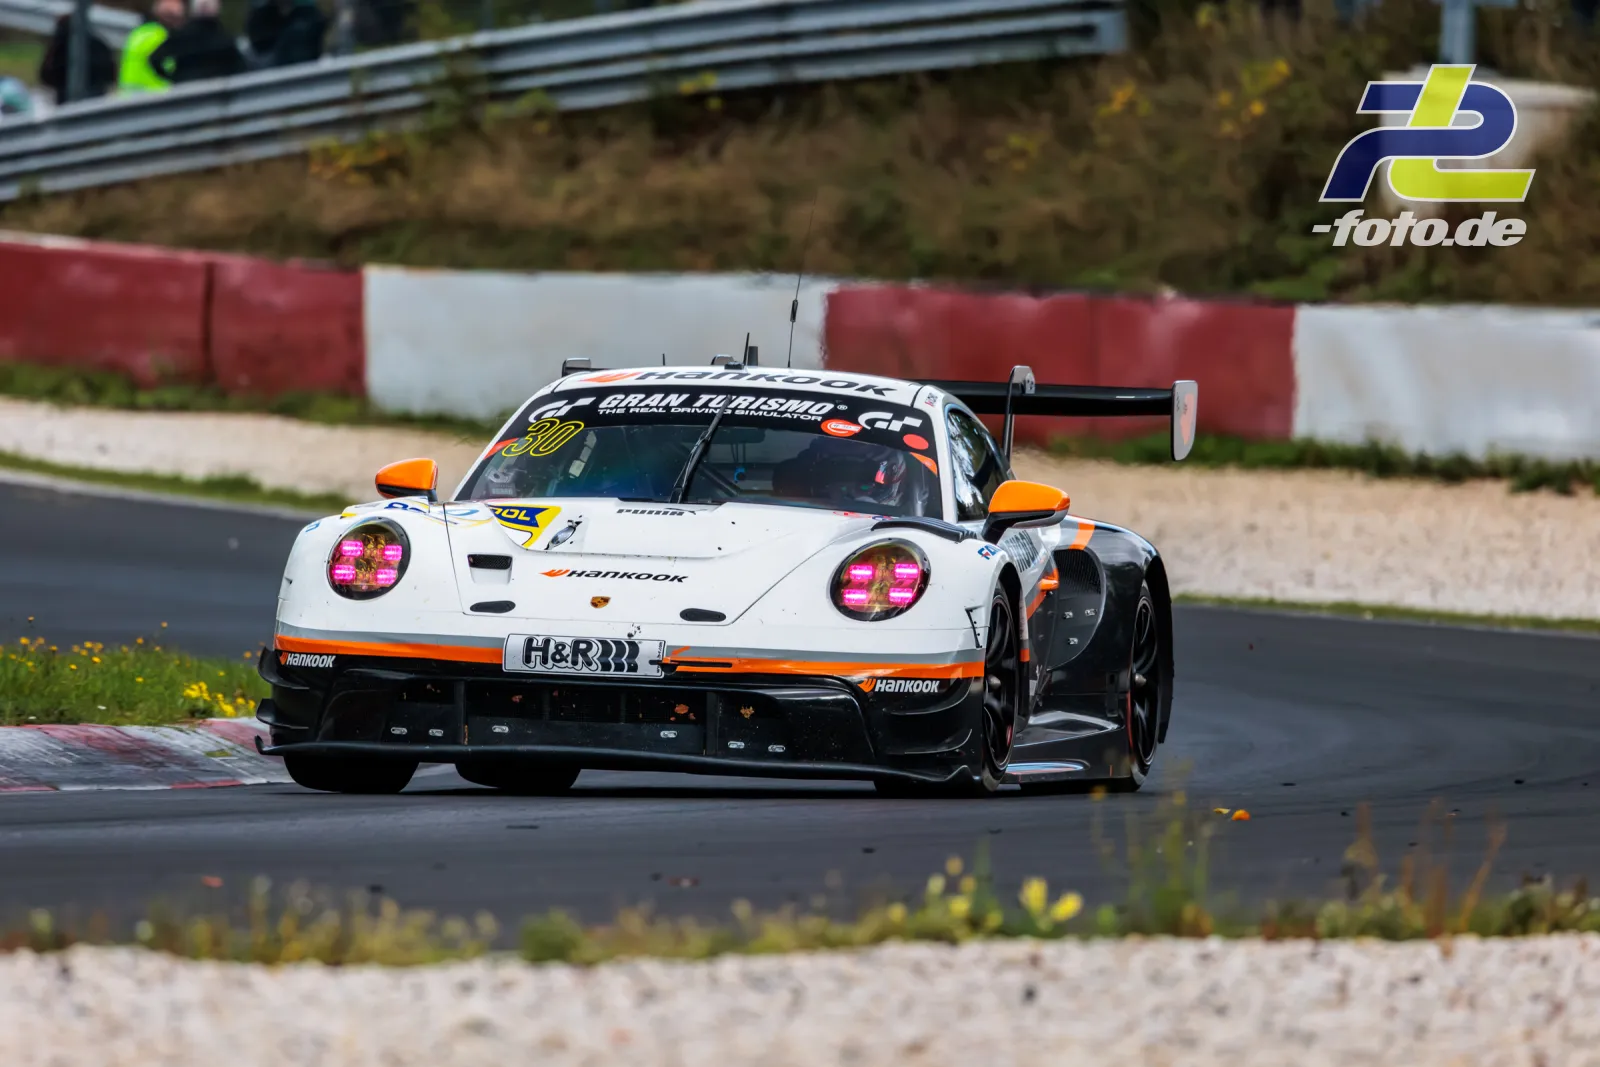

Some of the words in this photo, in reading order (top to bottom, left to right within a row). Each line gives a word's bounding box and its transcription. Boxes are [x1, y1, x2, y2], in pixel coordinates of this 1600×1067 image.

[598, 393, 690, 409] GRAN
[692, 394, 835, 416] TURISMO
[670, 407, 732, 415] DRIVING
[734, 409, 823, 422] SIMULATOR
[502, 418, 585, 457] 30
[523, 636, 600, 672] H&R
